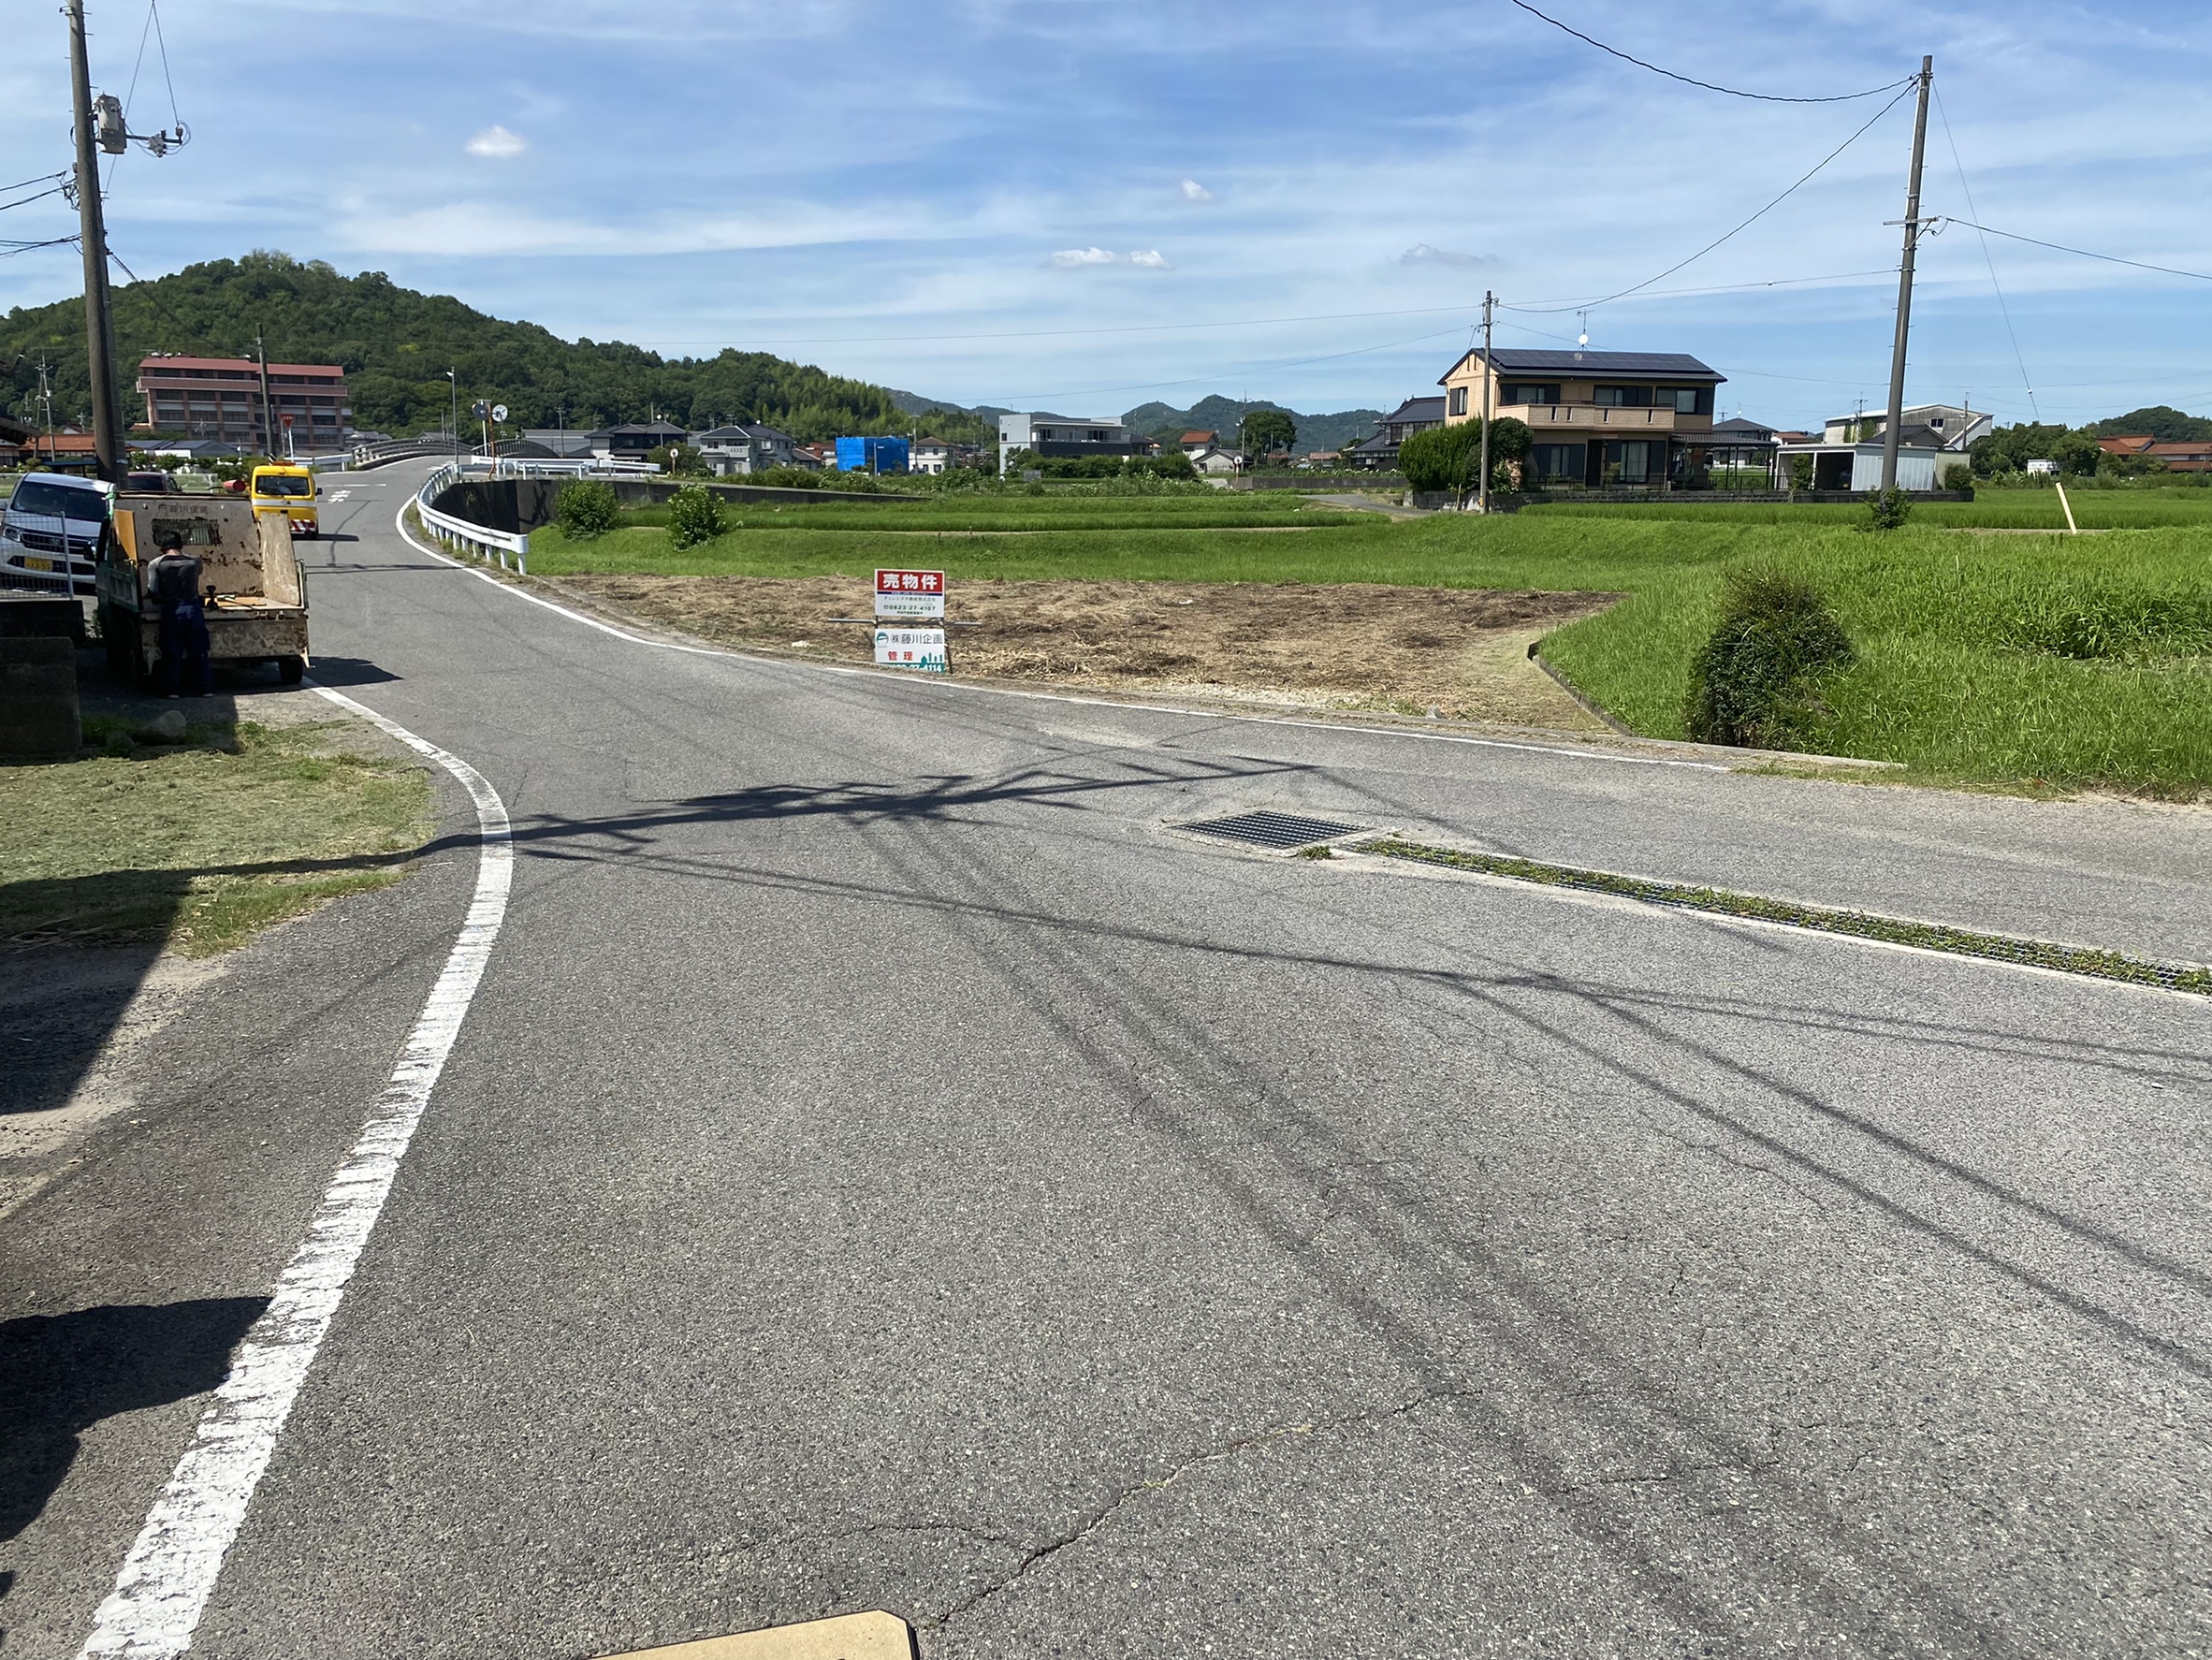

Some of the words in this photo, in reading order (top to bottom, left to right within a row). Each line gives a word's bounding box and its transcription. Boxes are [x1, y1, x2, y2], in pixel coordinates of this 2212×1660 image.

[883, 574, 938, 590] 売物件
[888, 651, 913, 661] 管理
